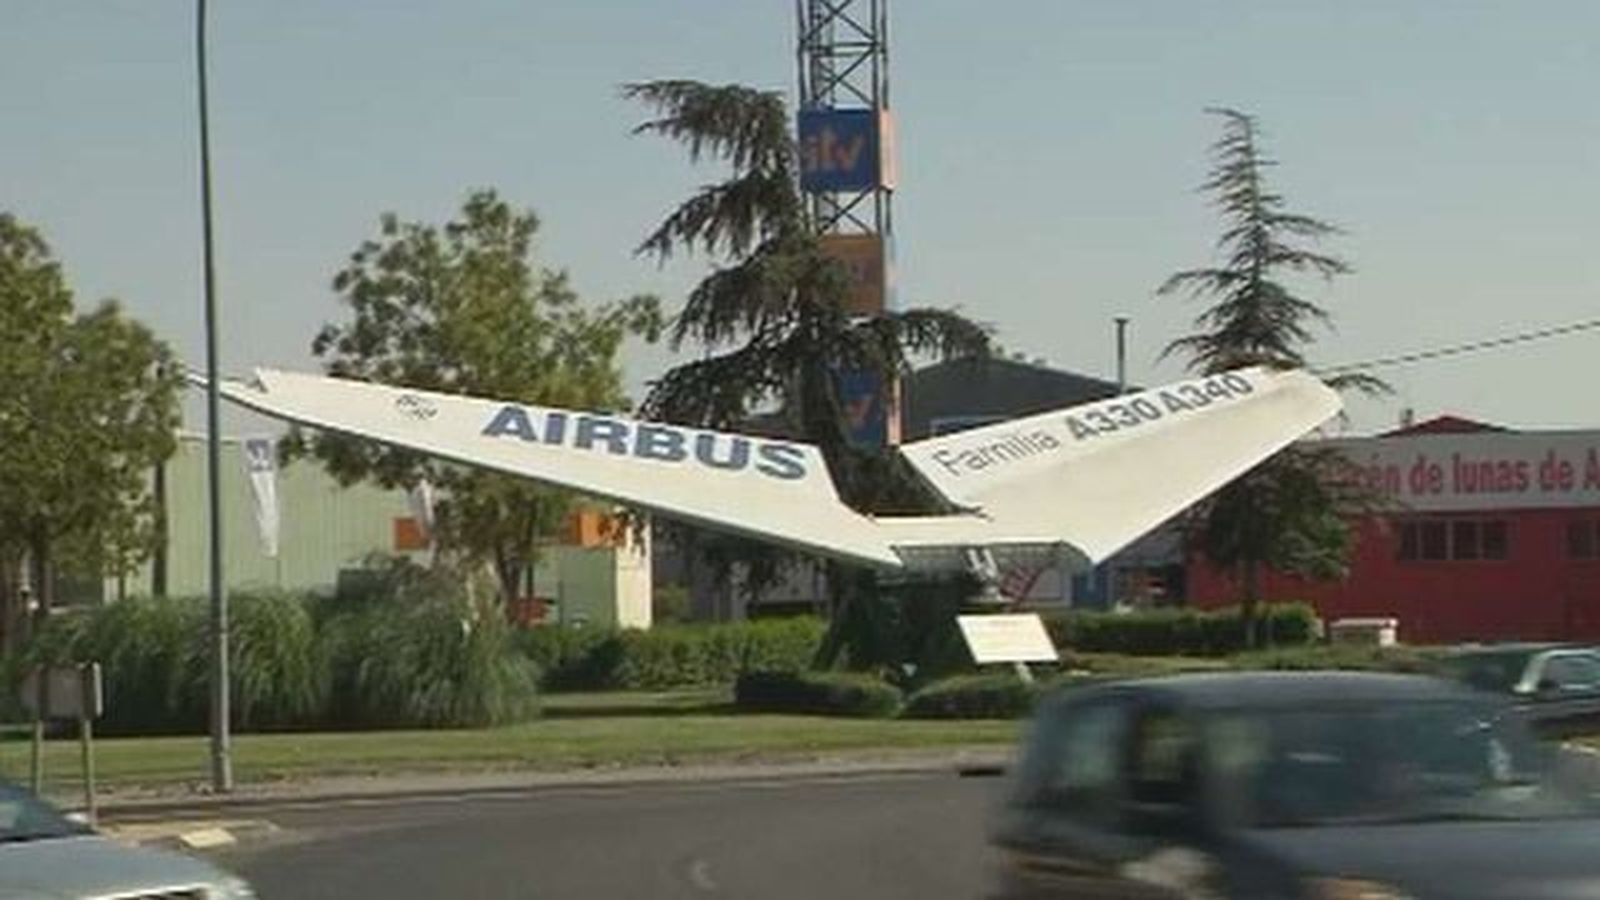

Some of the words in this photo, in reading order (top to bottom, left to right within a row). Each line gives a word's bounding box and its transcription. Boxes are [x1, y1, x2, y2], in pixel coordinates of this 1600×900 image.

[481, 404, 808, 480] AIRBUS
[932, 429, 1060, 477] Familia
[1065, 397, 1163, 440] A330
[1157, 373, 1254, 413] A340
[1408, 454, 1443, 495] de
[1452, 452, 1529, 493] lunas
[1539, 451, 1574, 491] de
